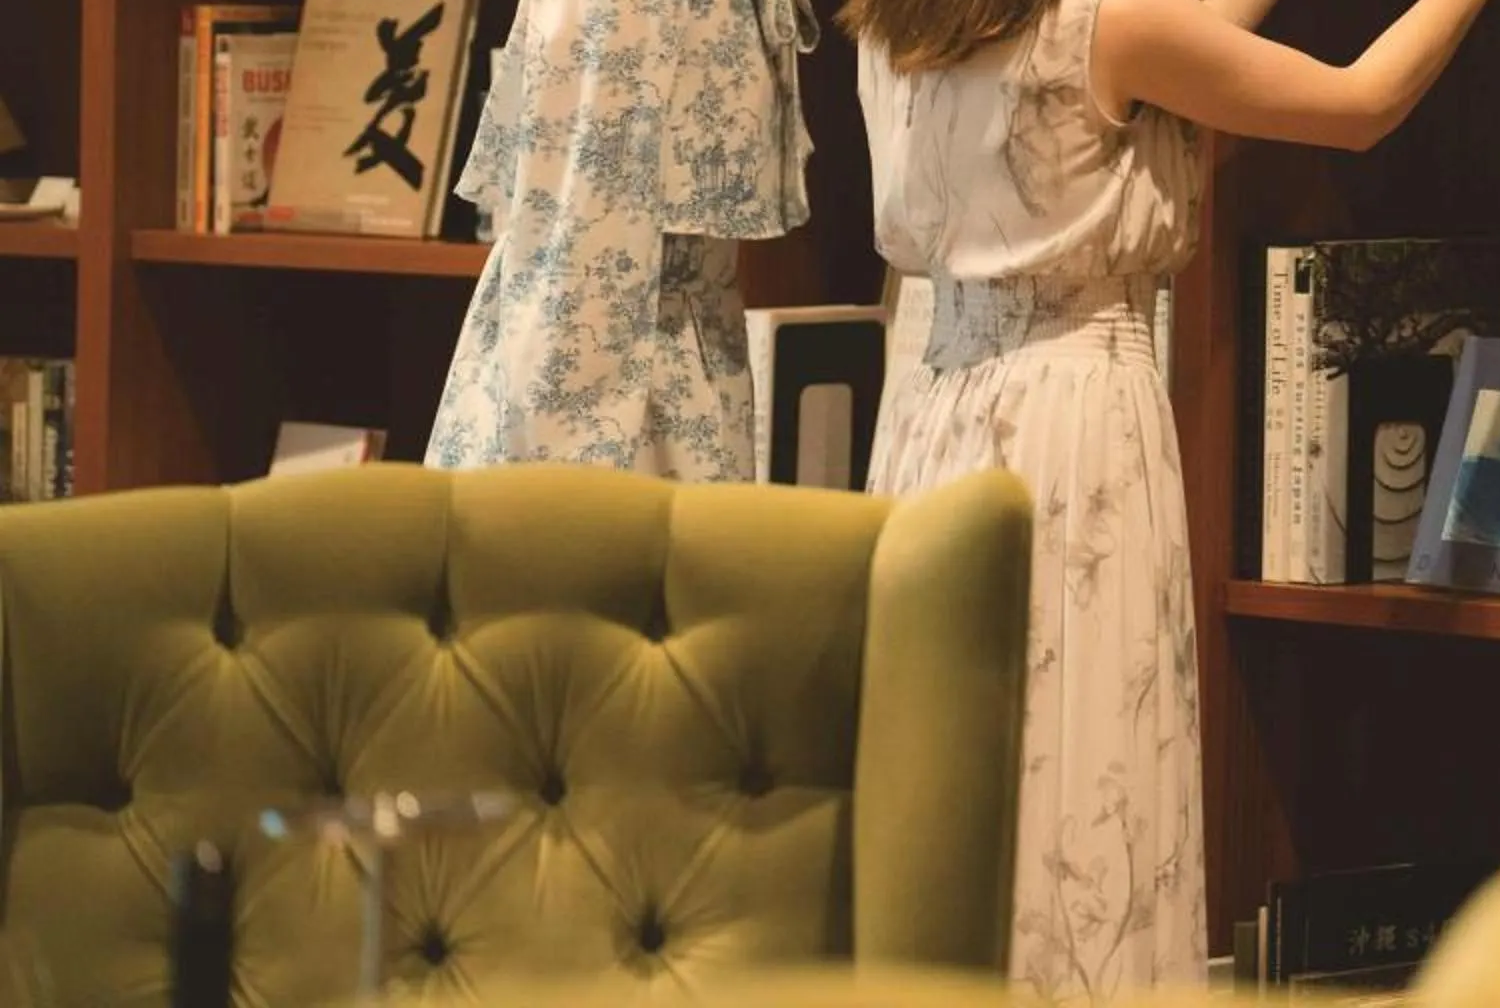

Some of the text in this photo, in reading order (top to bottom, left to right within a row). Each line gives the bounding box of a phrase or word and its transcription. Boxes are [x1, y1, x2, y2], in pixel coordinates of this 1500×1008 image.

[1273, 272, 1290, 320] Time
[1273, 328, 1289, 352] of
[1272, 357, 1288, 395] Life
[1291, 465, 1304, 525] Japan
